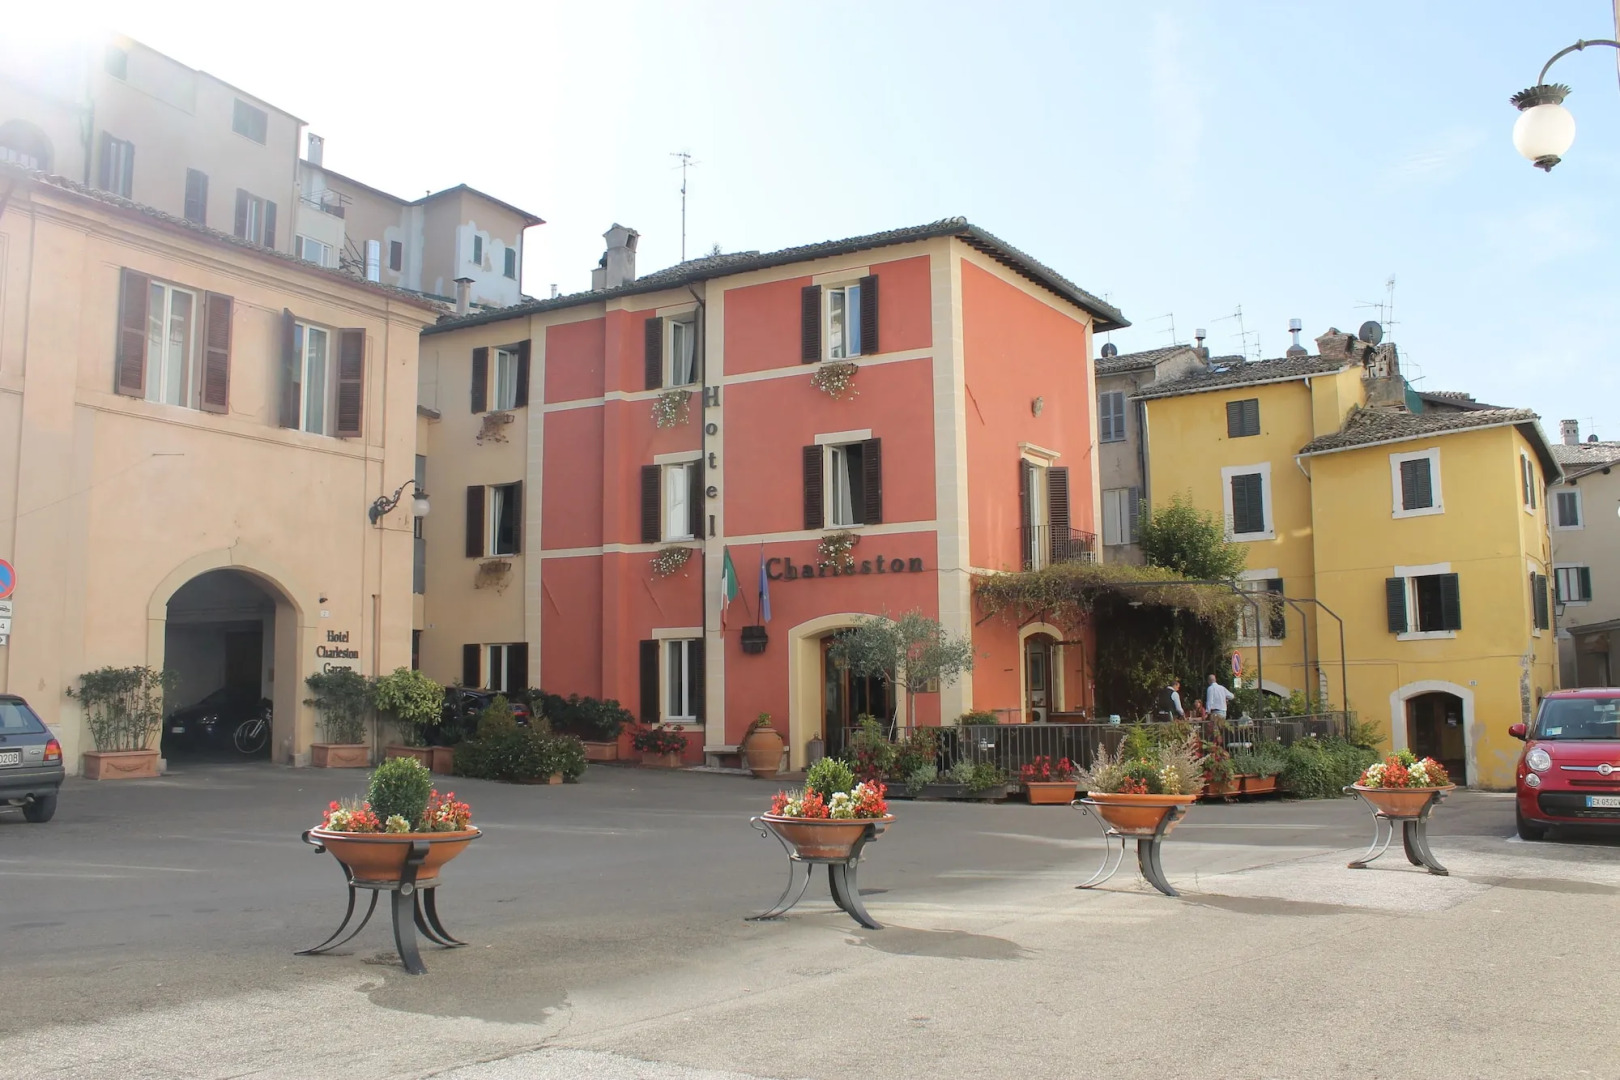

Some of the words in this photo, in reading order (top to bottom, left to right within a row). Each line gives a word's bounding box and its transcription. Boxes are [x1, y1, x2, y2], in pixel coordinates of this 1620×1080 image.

[704, 385, 720, 538] Hotel
[327, 630, 350, 643] Hotel
[316, 645, 359, 659] Charleston
